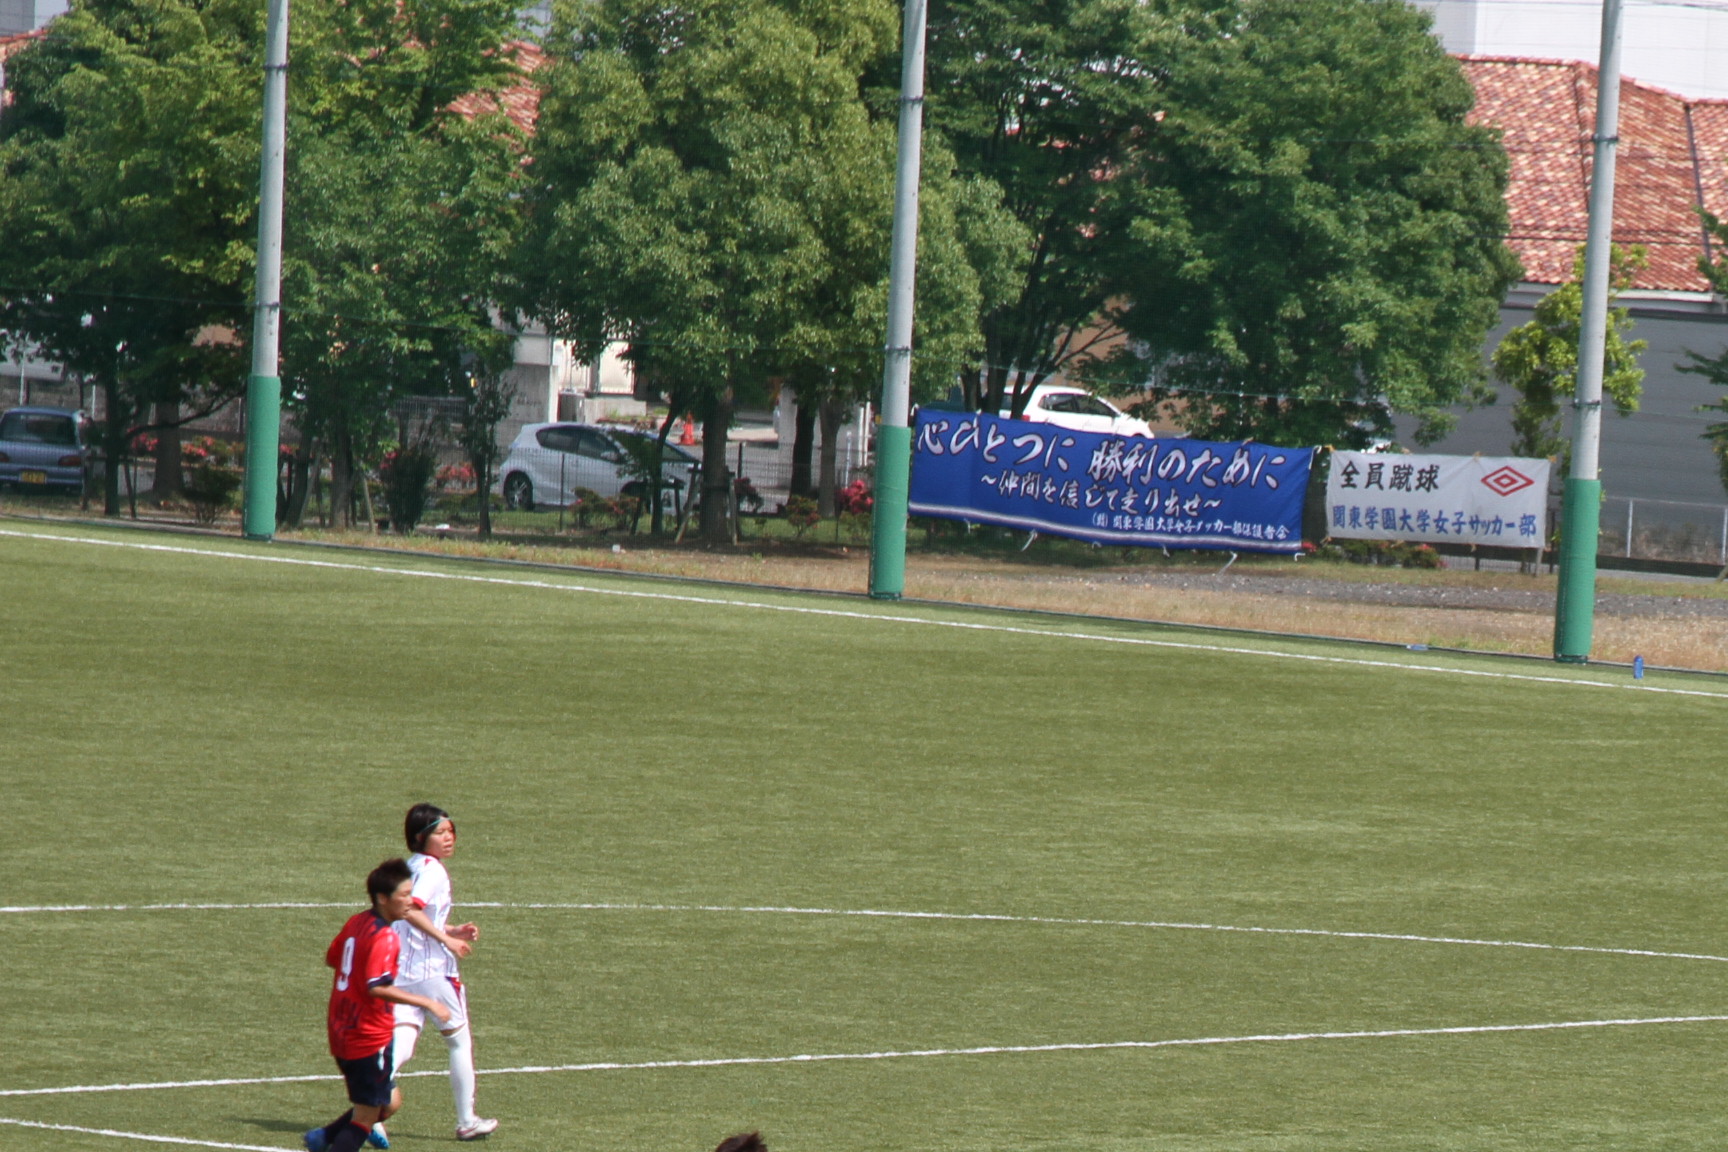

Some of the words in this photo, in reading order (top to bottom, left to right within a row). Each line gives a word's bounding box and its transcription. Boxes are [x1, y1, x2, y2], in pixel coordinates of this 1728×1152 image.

[917, 418, 1075, 472] 心ひとつに
[1086, 438, 1287, 490] 勝利のために
[1340, 460, 1441, 493] 全員蹴球
[1332, 504, 1537, 538] 関東学園大学女子サッカー部
[336, 936, 356, 992] 9
